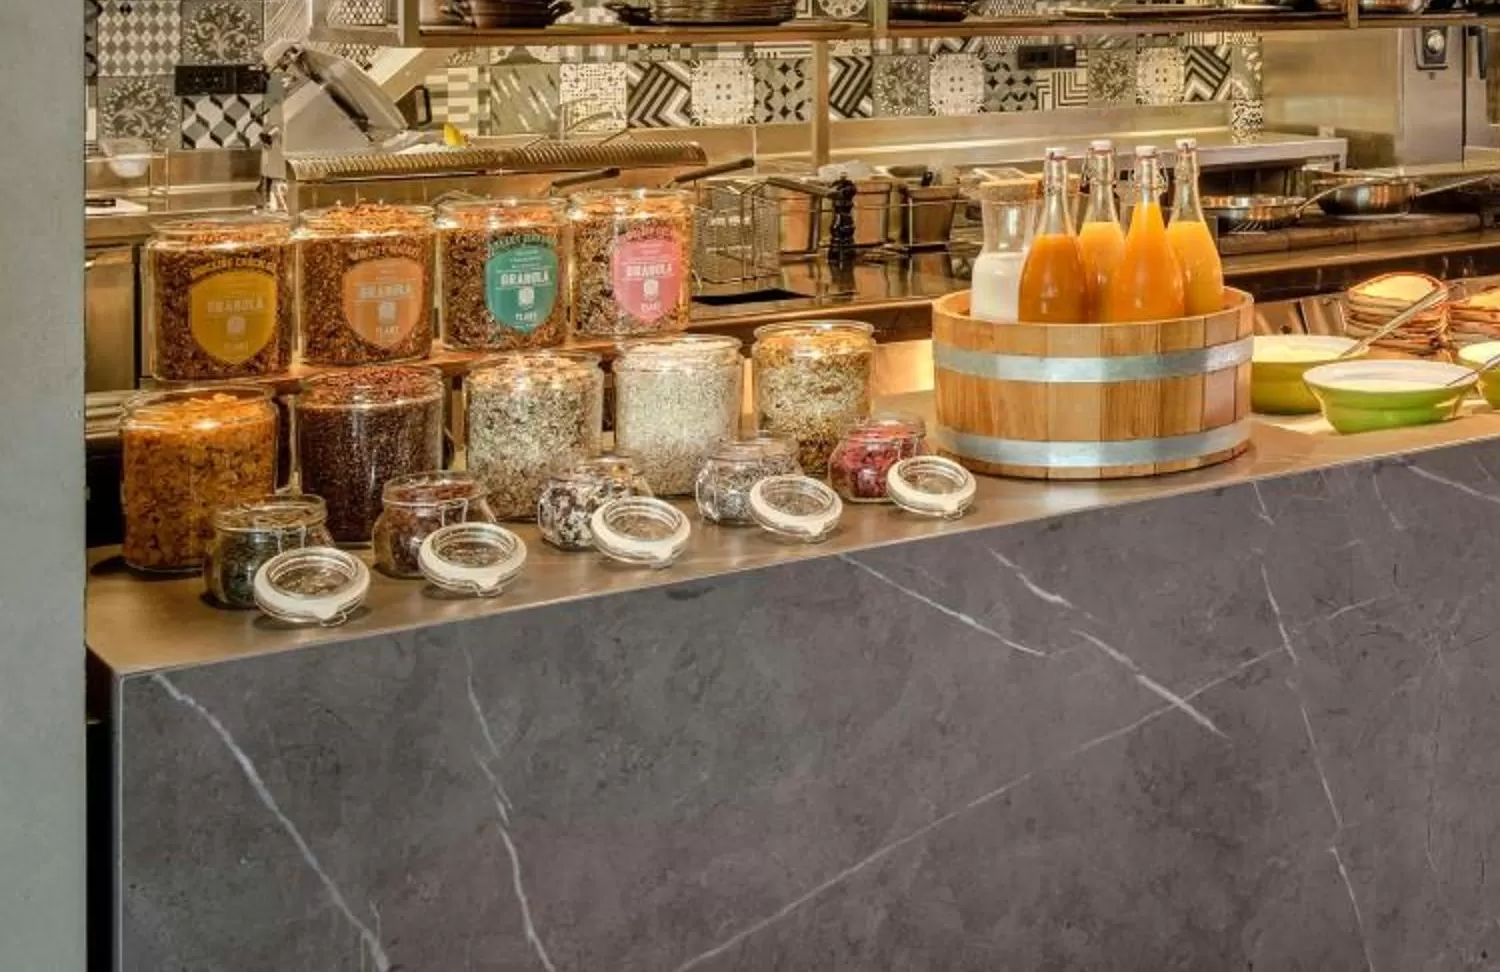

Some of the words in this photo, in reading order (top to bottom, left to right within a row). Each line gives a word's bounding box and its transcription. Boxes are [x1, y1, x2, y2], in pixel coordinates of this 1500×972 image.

[500, 269, 549, 287] GRANOLA
[627, 262, 672, 277] GRANOLA
[359, 281, 412, 299] GRANOLA
[206, 293, 264, 313] GRANOLA
